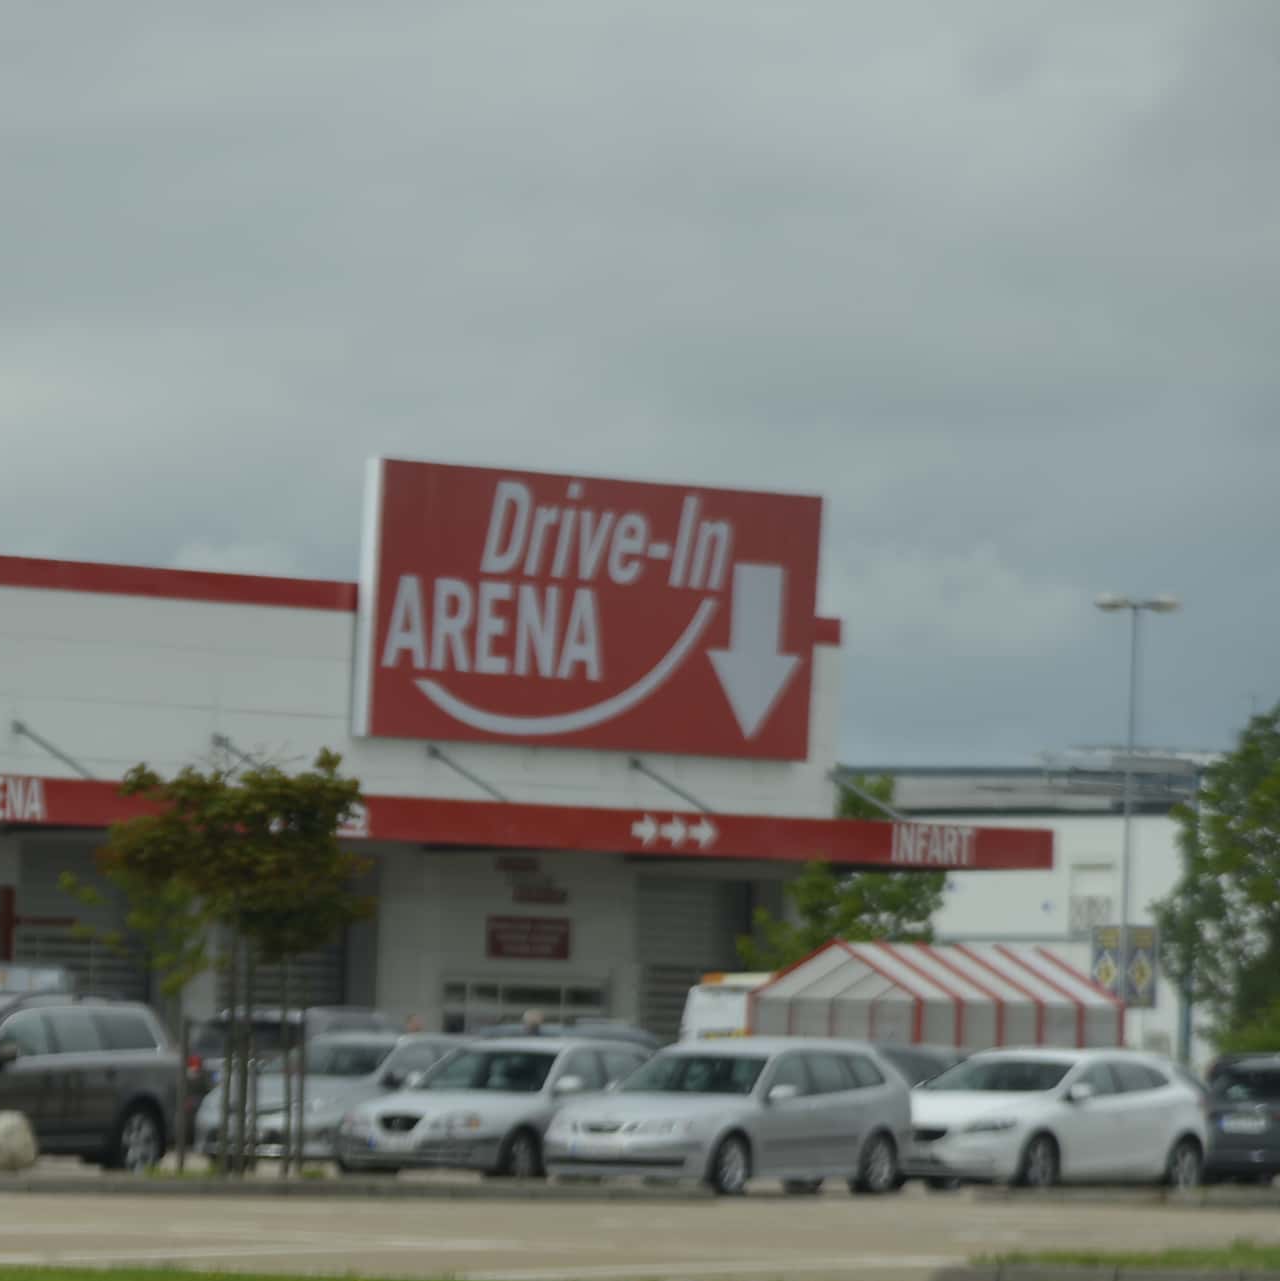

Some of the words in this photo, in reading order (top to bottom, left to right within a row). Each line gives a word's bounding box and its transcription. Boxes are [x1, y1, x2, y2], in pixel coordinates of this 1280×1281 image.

[479, 480, 731, 591] Drive-In
[381, 574, 601, 682] ARENA
[892, 822, 973, 866] INFART
